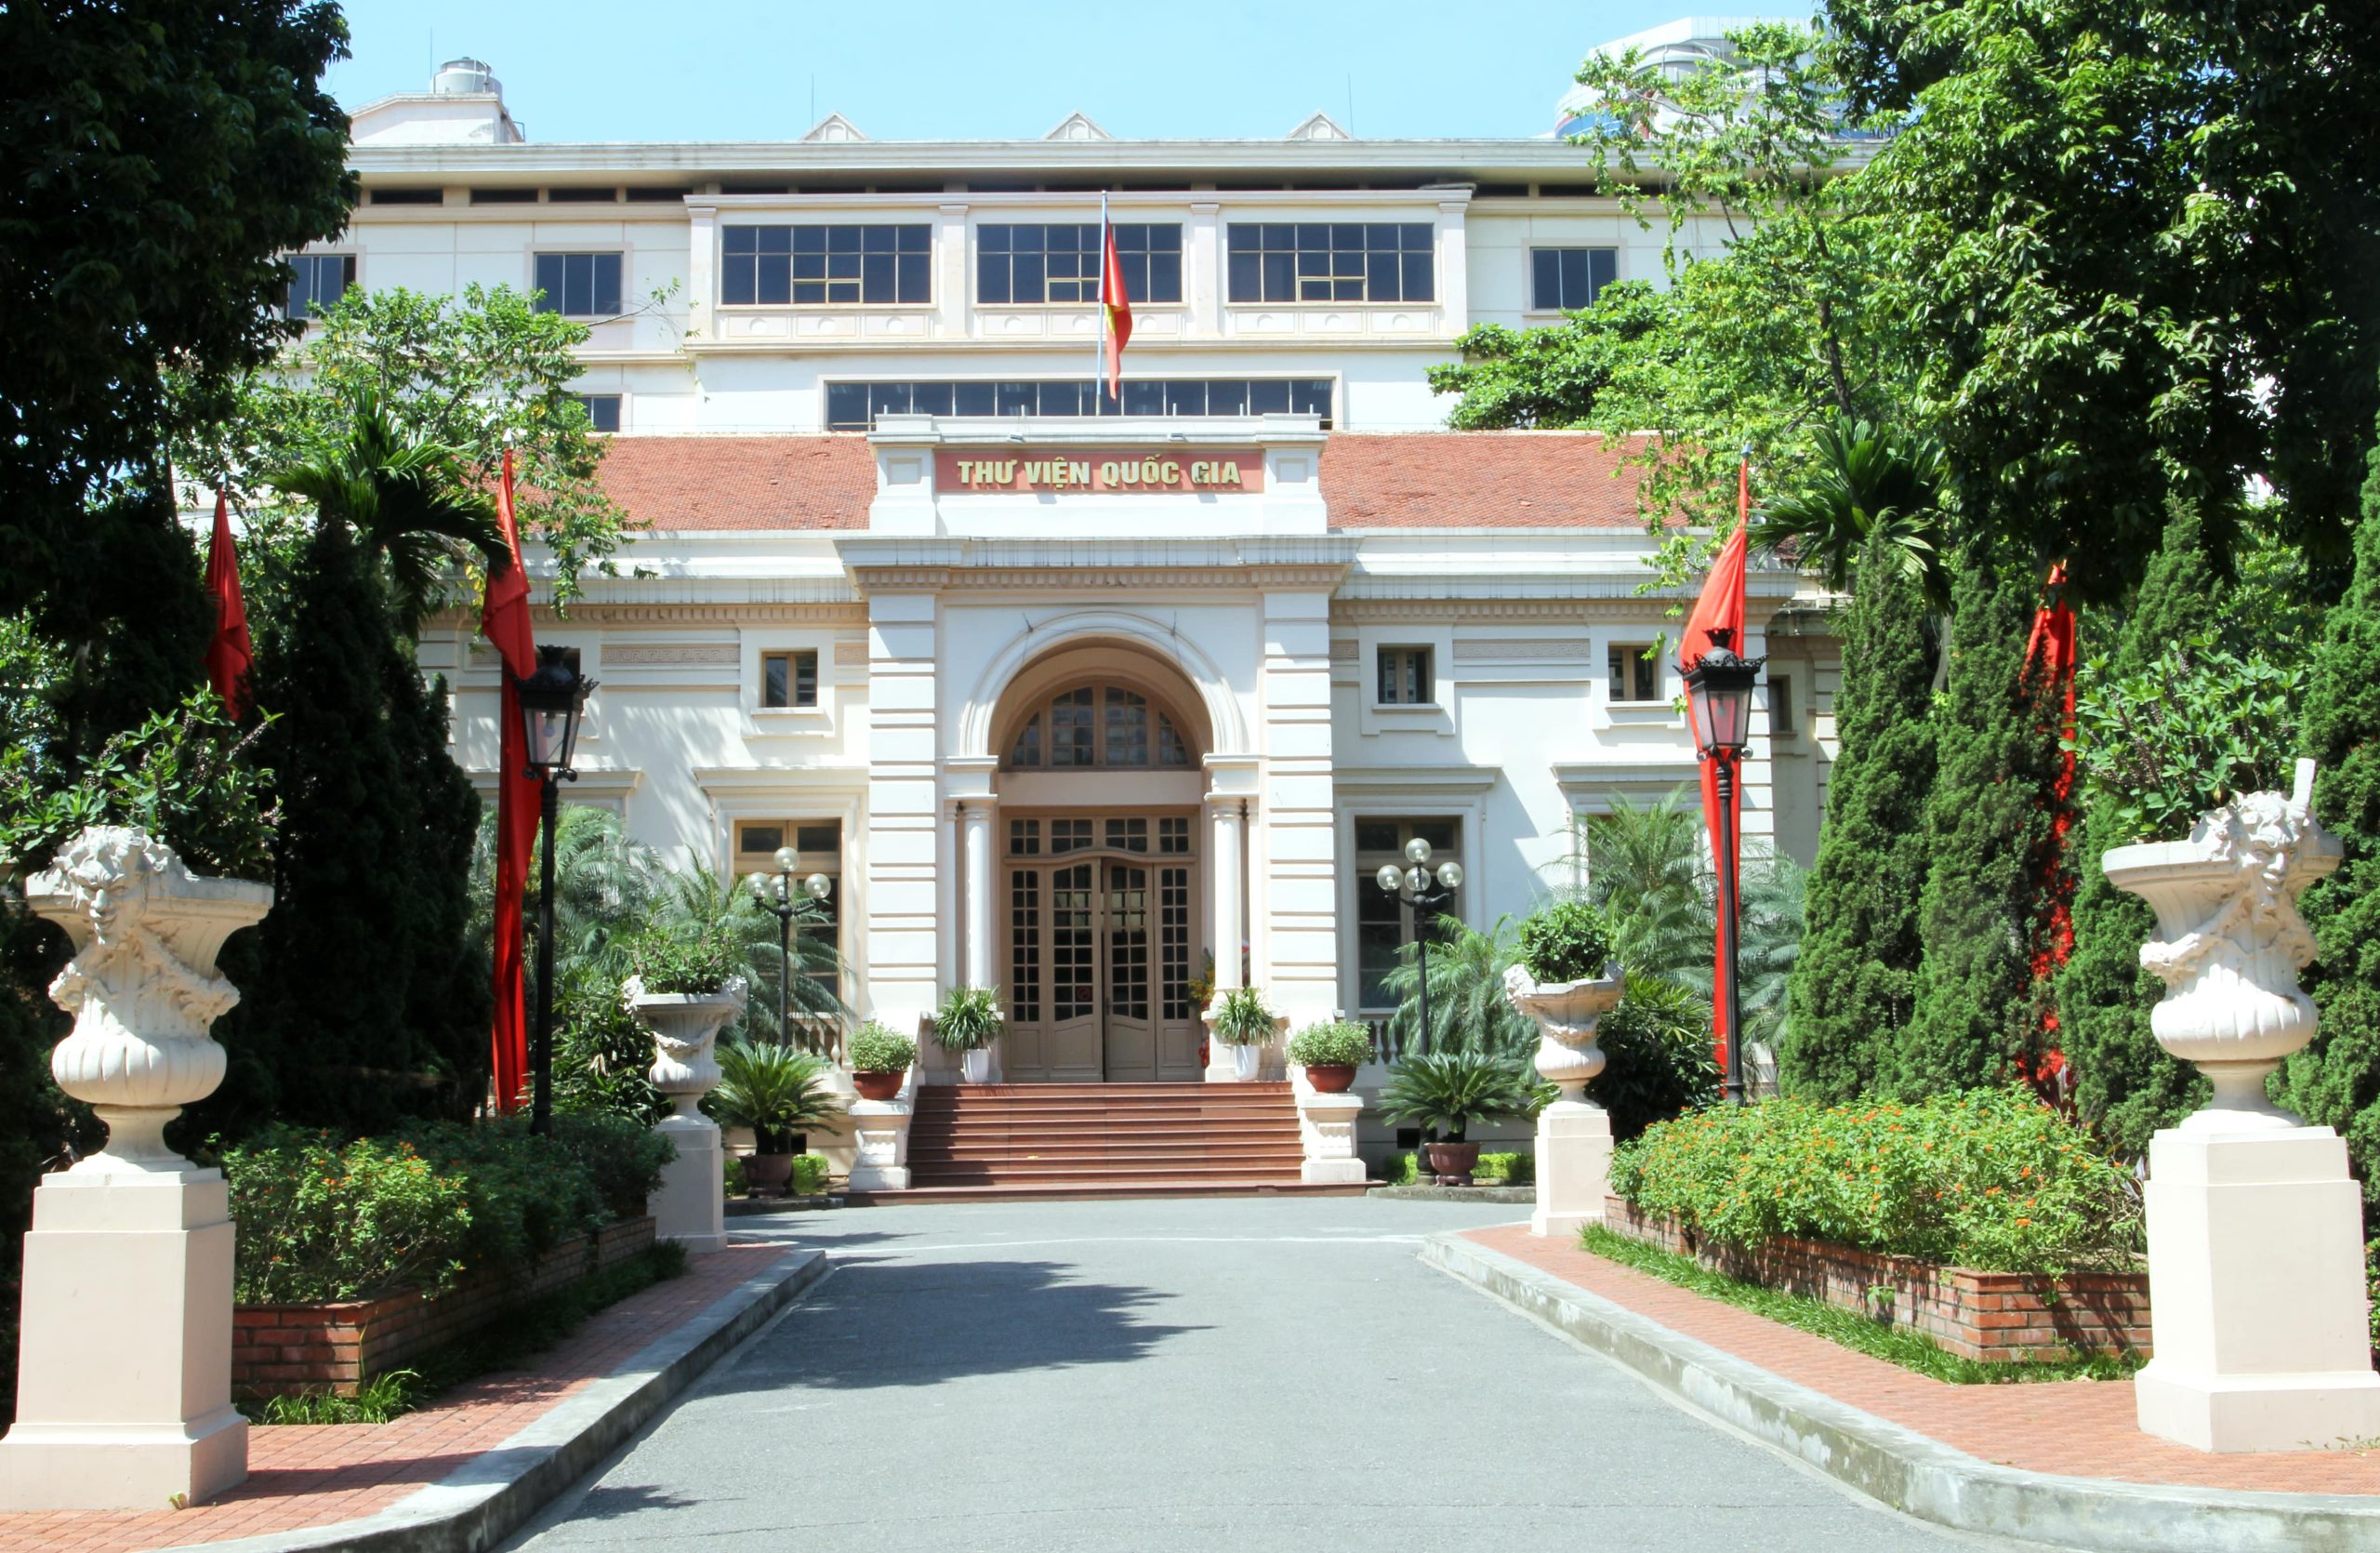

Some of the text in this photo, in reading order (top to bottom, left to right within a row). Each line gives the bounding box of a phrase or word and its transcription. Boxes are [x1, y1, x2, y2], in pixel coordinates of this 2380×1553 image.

[958, 454, 1241, 488] THƯ VIỆN QUỐC GIA
